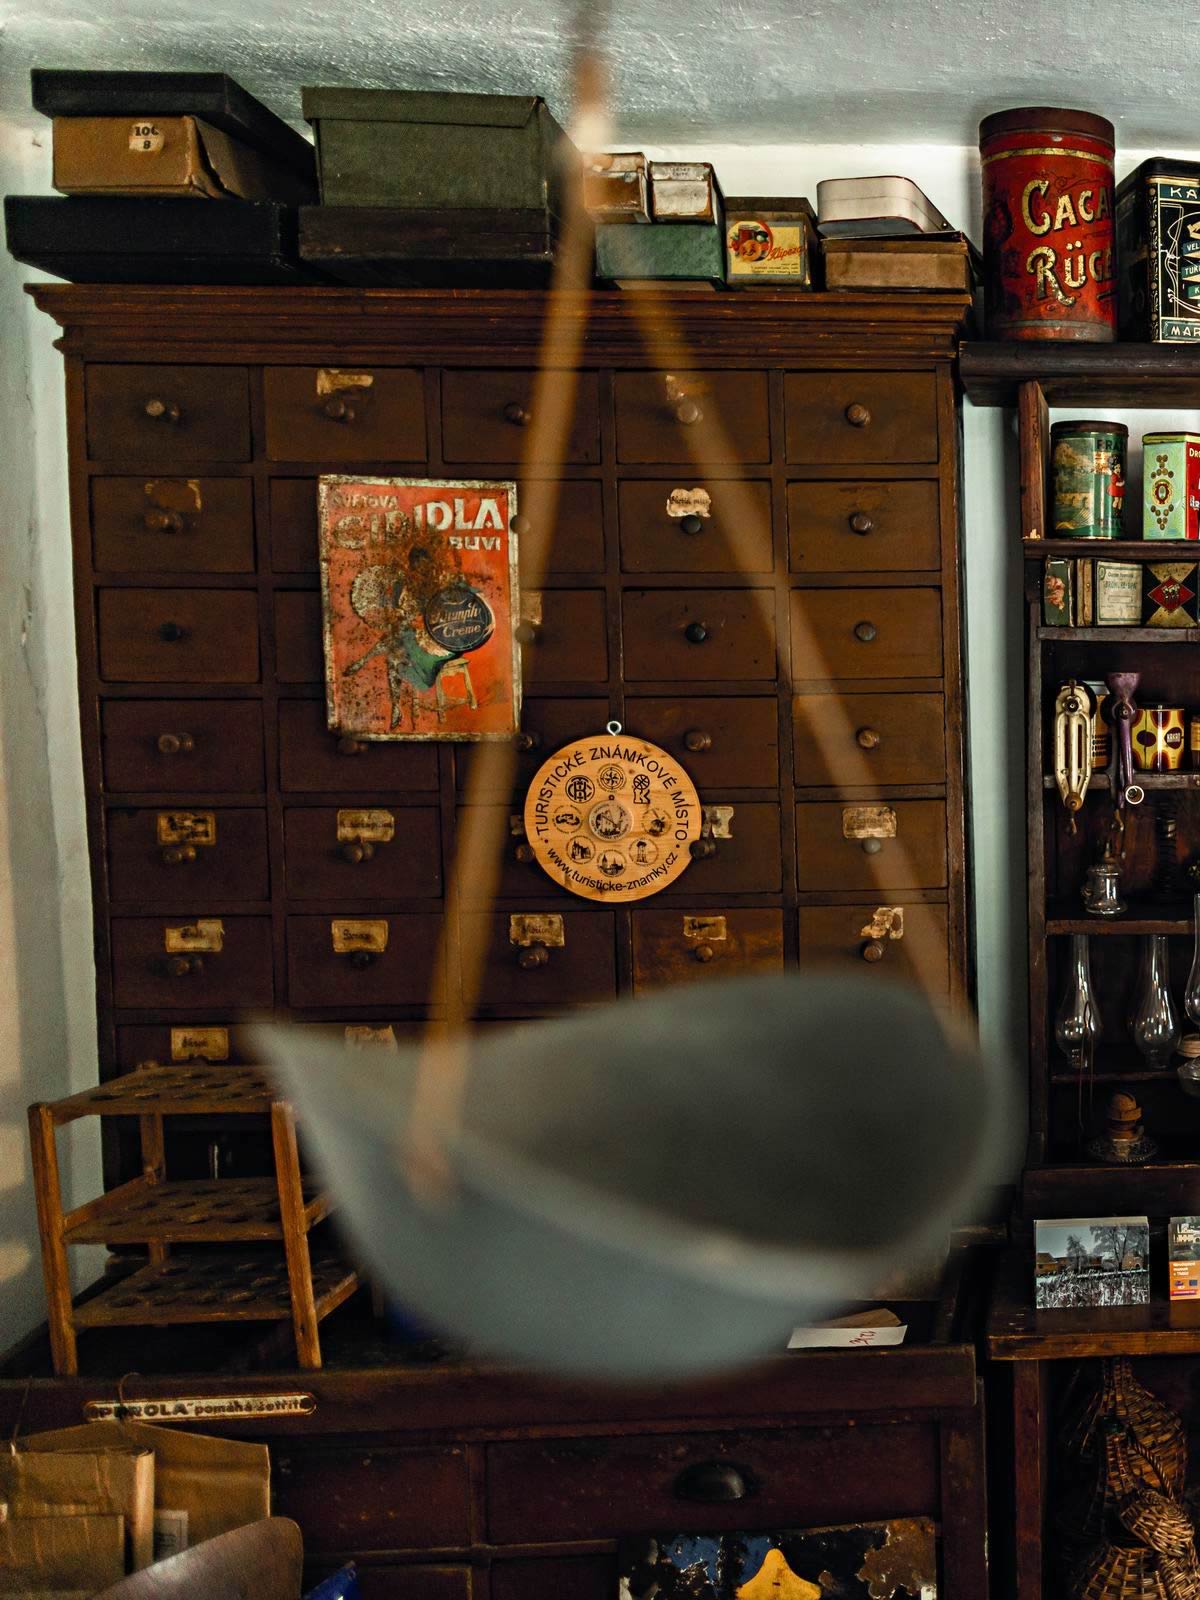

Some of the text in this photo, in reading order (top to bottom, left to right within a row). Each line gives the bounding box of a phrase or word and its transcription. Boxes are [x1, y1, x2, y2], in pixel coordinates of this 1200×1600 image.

[143, 140, 151, 150] 8
[535, 744, 695, 842] TURISTICKÉ ZNÁMKOVÉ MÍSTO
[546, 851, 678, 892] www.turisticke-znamky.cz
